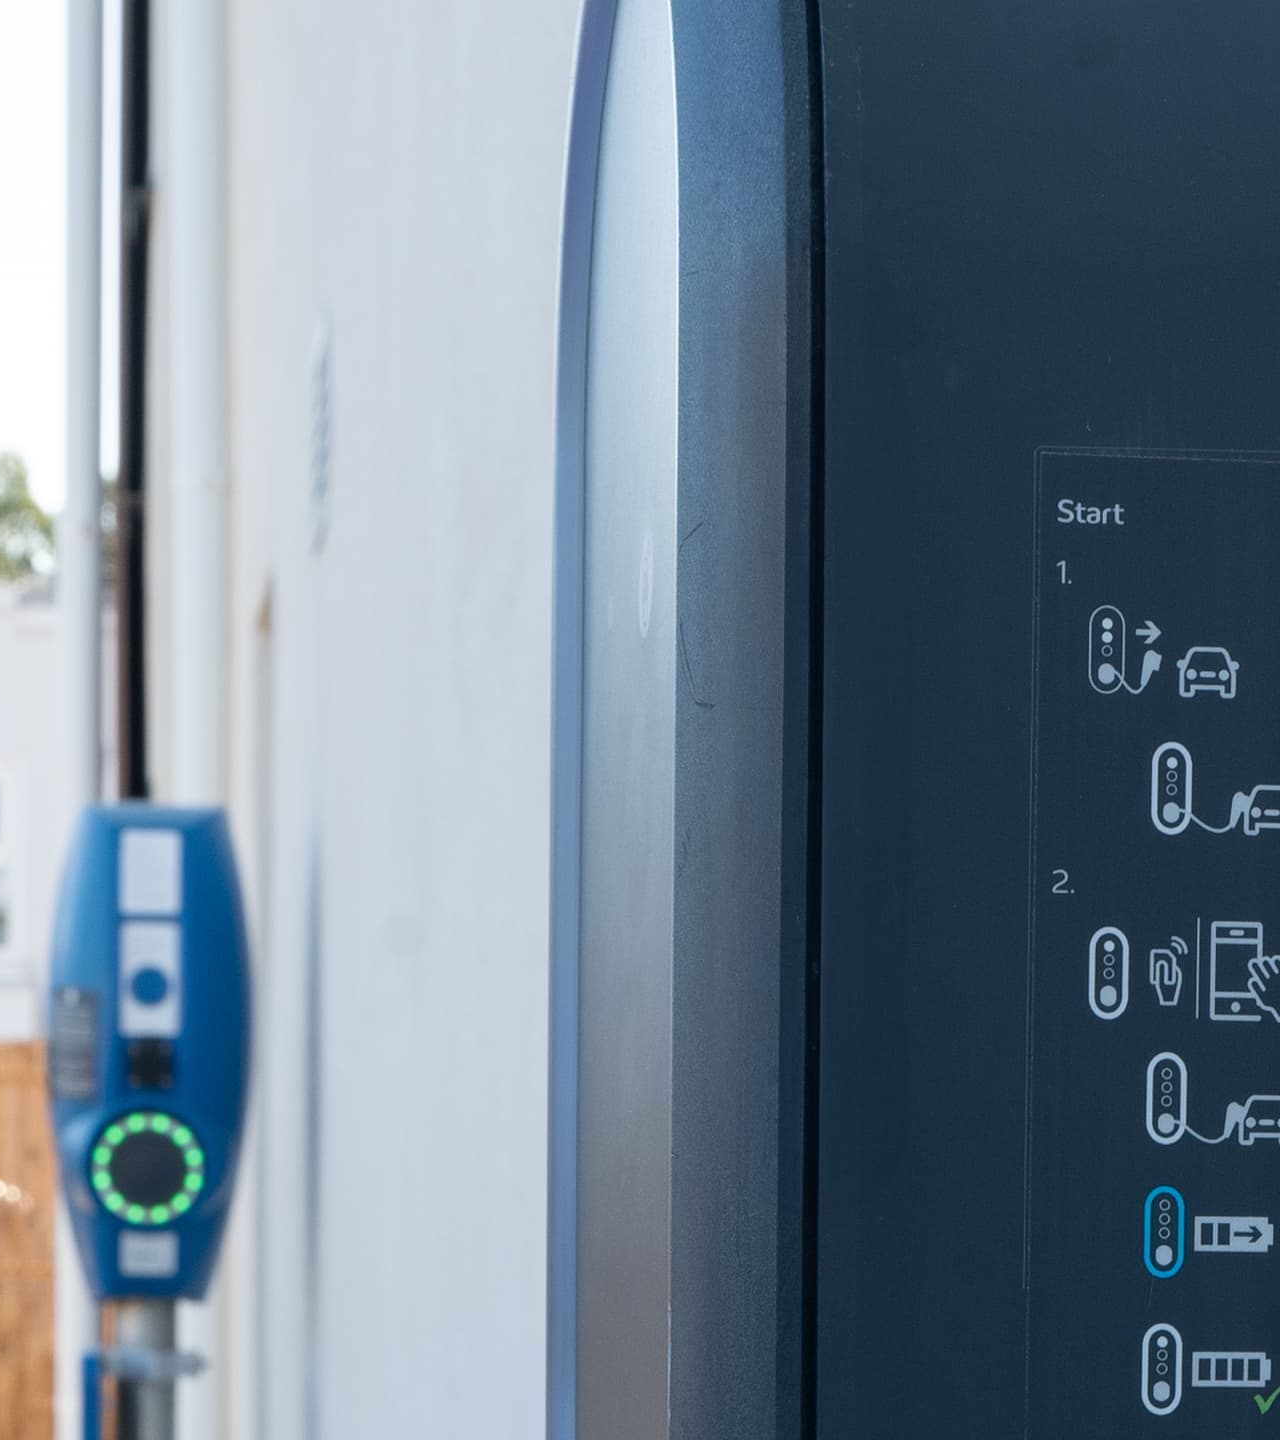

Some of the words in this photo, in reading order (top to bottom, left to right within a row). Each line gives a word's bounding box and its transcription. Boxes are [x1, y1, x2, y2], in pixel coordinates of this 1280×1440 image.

[1058, 499, 1124, 524] Start
[1057, 561, 1071, 584] 1.
[1052, 869, 1074, 893] 2.
